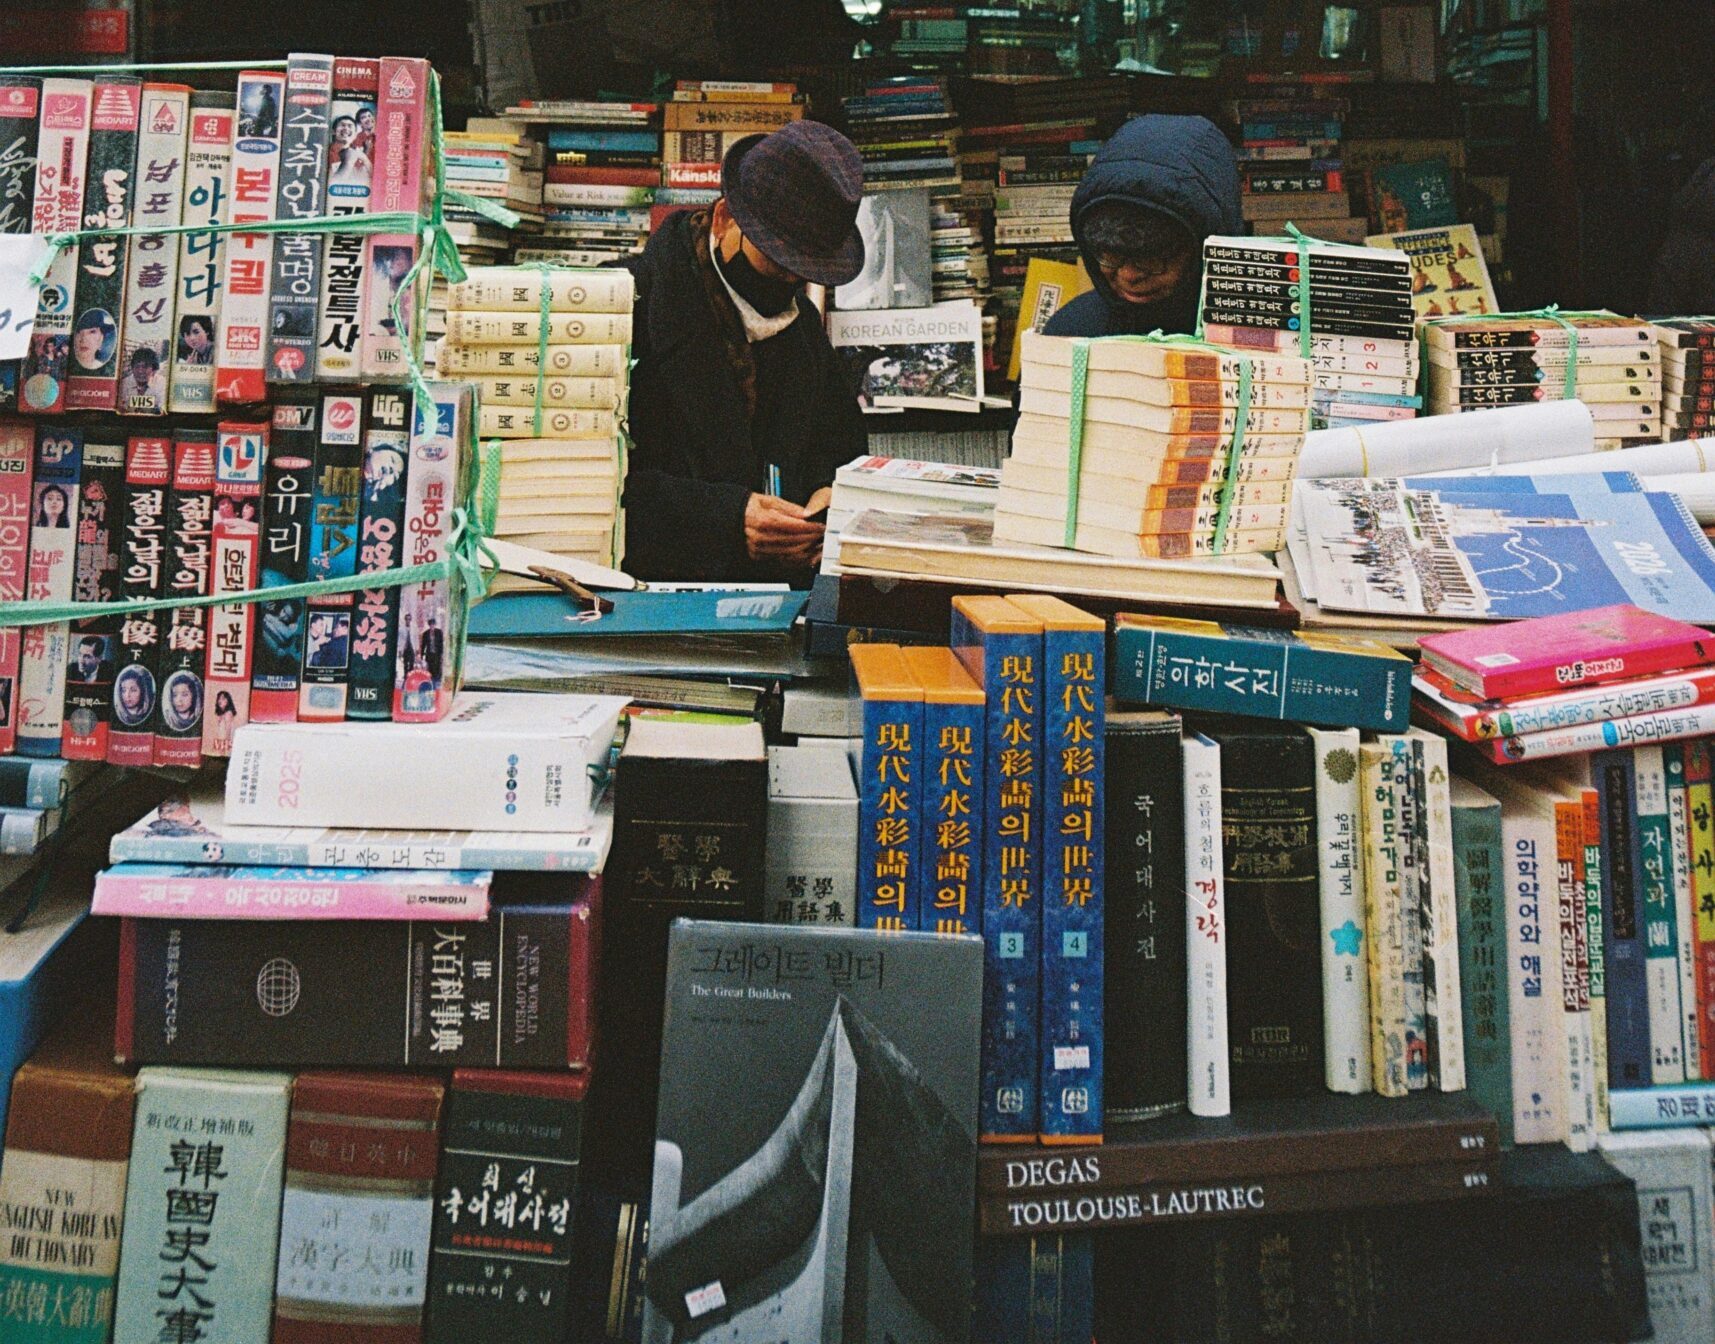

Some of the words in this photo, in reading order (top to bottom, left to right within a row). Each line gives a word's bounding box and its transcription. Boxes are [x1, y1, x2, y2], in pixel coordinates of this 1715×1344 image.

[293, 73, 326, 82] CREAM
[336, 67, 372, 75] CINEMA
[184, 176, 226, 307] 아다다
[229, 168, 271, 295] 본투킬
[1209, 248, 1241, 259] 도요토미
[1244, 251, 1278, 263] 히데요시
[1411, 252, 1458, 268] UDES
[1212, 264, 1244, 275] 도요토미
[1247, 267, 1281, 279] 히데요시
[1212, 280, 1244, 291] 도요토미
[1247, 283, 1281, 294] 히데요시
[1215, 297, 1247, 308] 도요토미
[1249, 300, 1283, 311] 히데요시
[1212, 312, 1244, 323] 도요토미
[1247, 315, 1281, 326] 히데요시
[840, 324, 901, 339] KOREAN
[906, 322, 968, 336] GARDEN
[1469, 332, 1511, 347] 서유기
[377, 350, 399, 361] VHS
[1364, 343, 1376, 351] 3
[1366, 361, 1378, 370] 2
[1471, 352, 1513, 368] 서유기
[1474, 369, 1516, 384] 서유기
[181, 388, 203, 397] VHS
[496, 383, 536, 397] 國志
[1474, 388, 1515, 402] 서유기
[131, 397, 154, 407] VHS
[129, 471, 168, 479] MEDIART
[269, 474, 312, 563] 유리
[214, 623, 242, 673] 침대
[1171, 657, 1278, 697] 의학사전
[355, 688, 377, 699] VHS
[1513, 701, 1594, 731] 장수풍뎅이
[1600, 691, 1666, 718] 사슴벌레
[1619, 720, 1671, 743] 동물
[278, 751, 300, 809] 2025
[1335, 814, 1349, 836] 우리
[324, 846, 445, 865] 곤충도감
[1330, 840, 1349, 853] 꽃
[1134, 795, 1156, 960] 국어대사전
[1644, 827, 1667, 908] 자연과
[787, 876, 834, 898] 醫學
[775, 901, 844, 922] 用語集
[1195, 878, 1218, 943] 경락
[1008, 938, 1016, 952] 3
[1070, 937, 1079, 951] 4
[529, 945, 540, 976] NEW
[691, 945, 816, 984] 그레이트
[825, 950, 885, 990] 빌더
[1520, 955, 1542, 997] 해설
[431, 928, 466, 1053] 大百科事典
[470, 961, 491, 1022] 世界
[514, 934, 528, 1045] ENCYCLOPEDIA
[691, 984, 710, 997] The
[714, 986, 744, 999] Great
[748, 987, 792, 1001] Builders
[527, 981, 539, 1036] WORLD
[482, 1162, 536, 1195] 최신
[1006, 1157, 1100, 1189] DEGAS
[45, 1188, 77, 1205] NEW
[1008, 1186, 1265, 1227] TOULOUSE-LAUTREC
[0, 1203, 52, 1232] NGLISH
[441, 1187, 571, 1236] 국어대사전
[10, 1235, 97, 1267] DICTIONARY
[0, 1277, 111, 1328] 英韓大辭典
